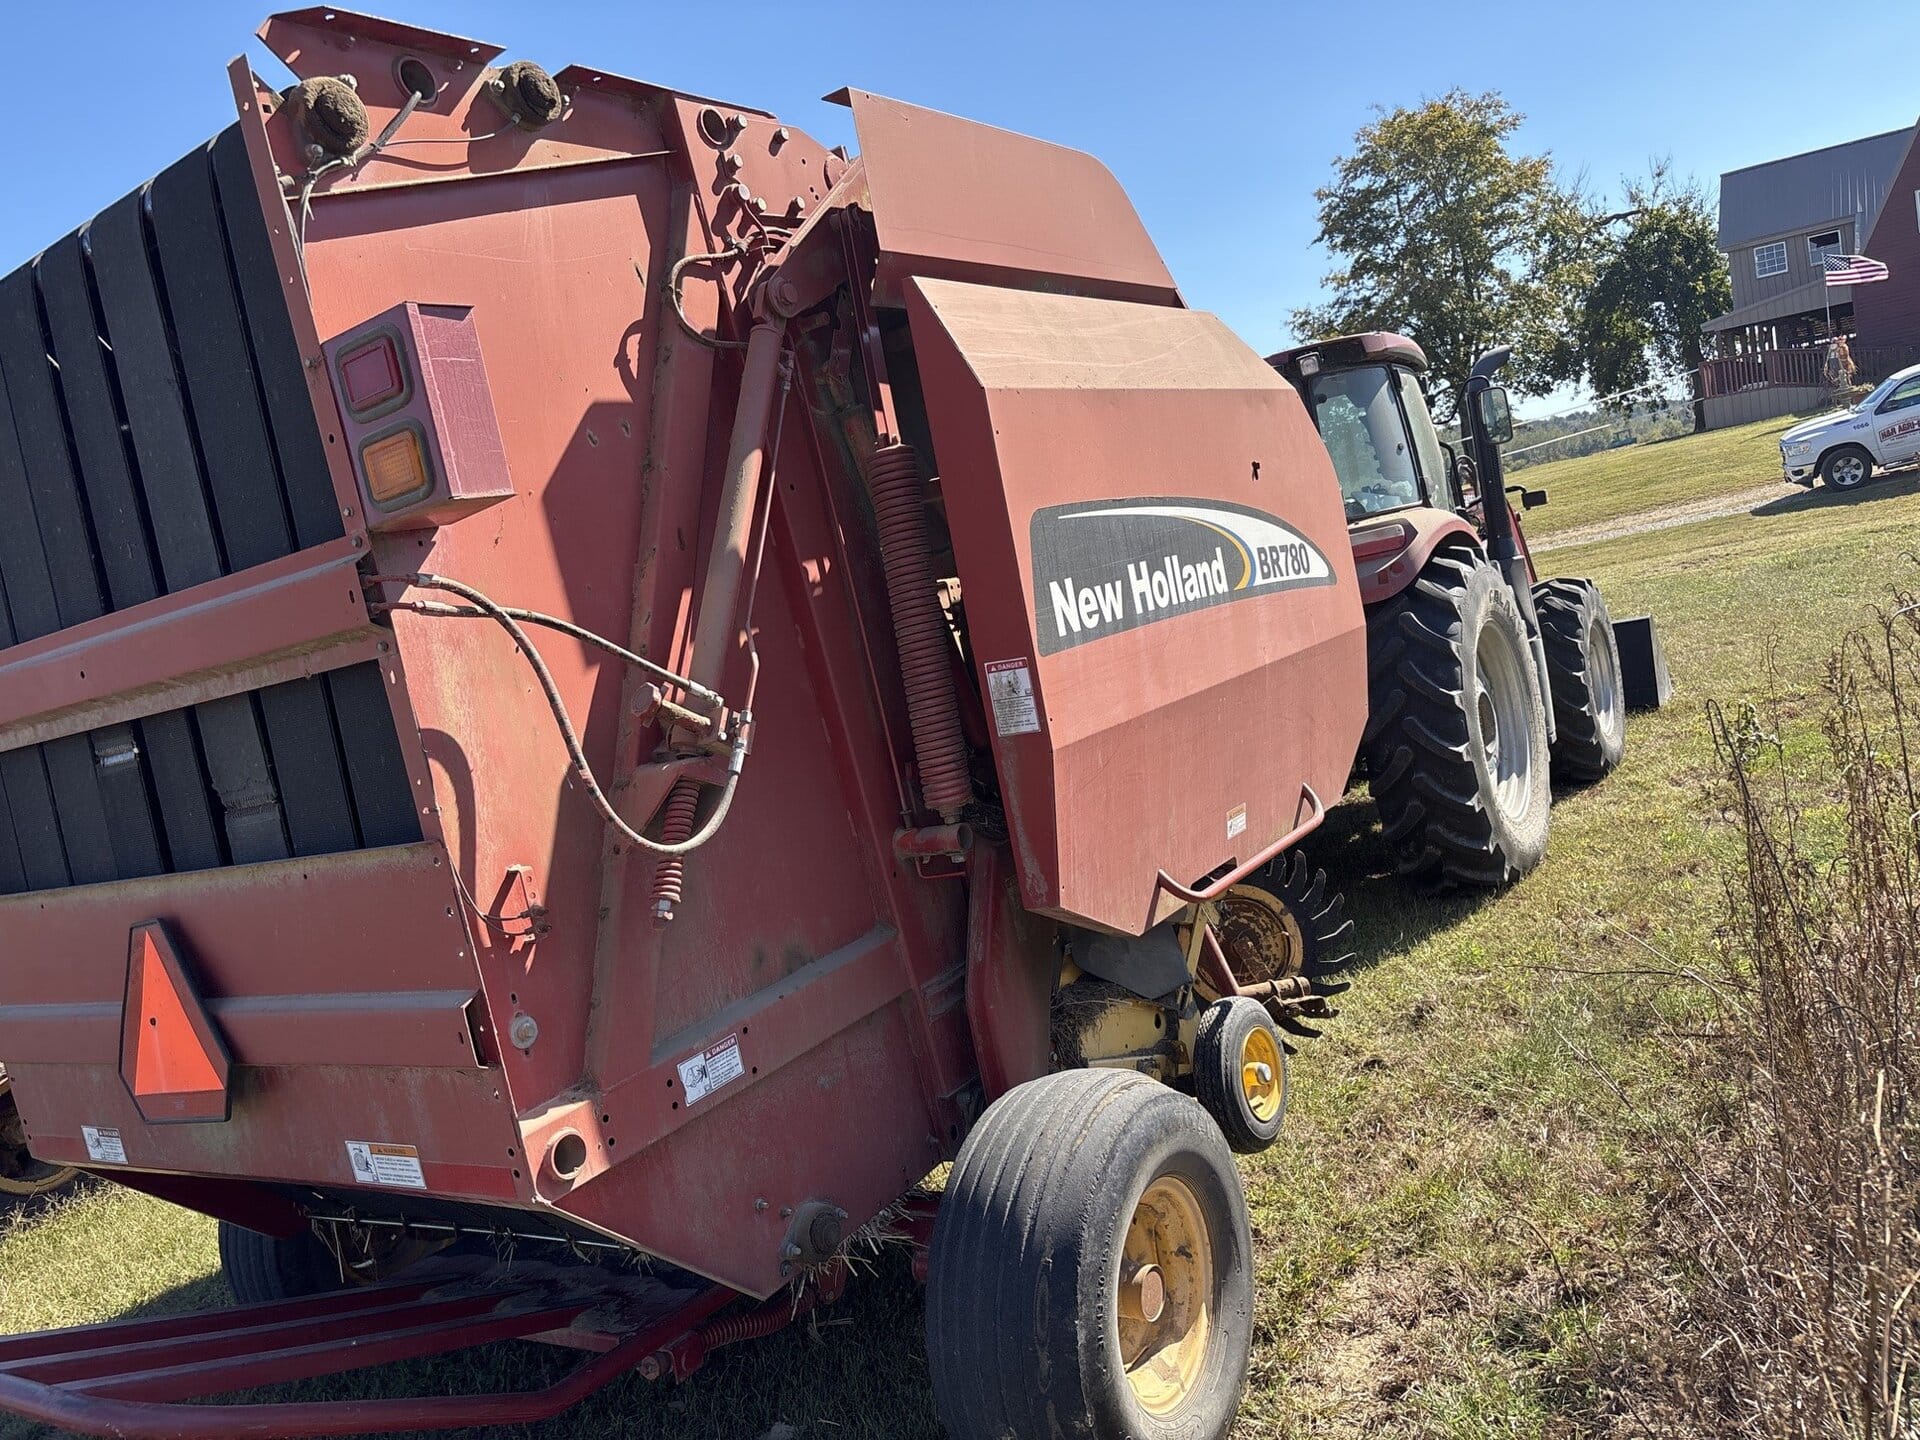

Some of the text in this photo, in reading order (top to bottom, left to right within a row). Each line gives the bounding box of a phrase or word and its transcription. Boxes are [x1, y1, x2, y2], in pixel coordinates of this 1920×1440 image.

[1898, 420, 1920, 432] AGRI-
[1256, 543, 1311, 580] BR780
[1049, 547, 1229, 637] New Holland
[997, 661, 1024, 671] DANGER
[711, 1037, 736, 1055] DANGER
